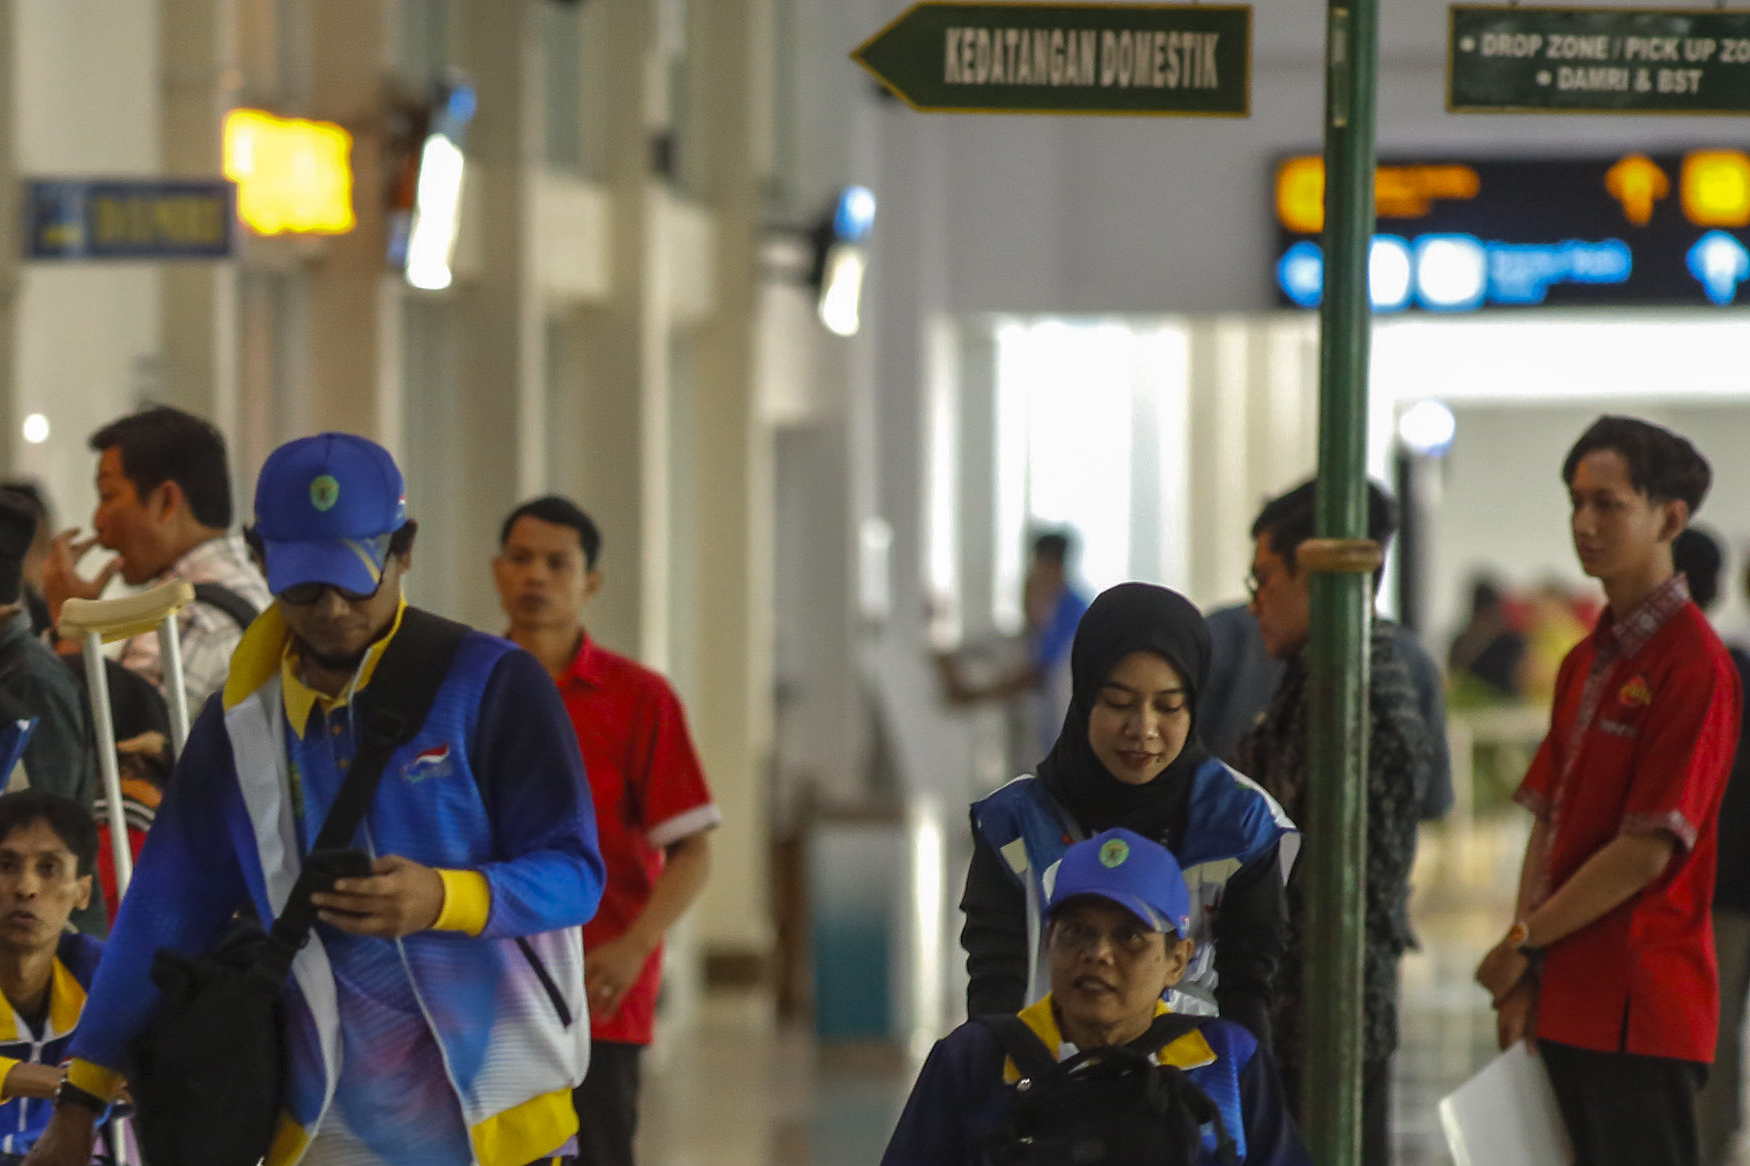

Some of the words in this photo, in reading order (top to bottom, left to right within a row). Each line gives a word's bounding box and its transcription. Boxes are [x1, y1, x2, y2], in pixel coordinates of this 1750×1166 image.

[945, 28, 1097, 87] KEDATANGAN
[1101, 29, 1219, 89] DOMESTIK
[1480, 32, 1543, 57] DROP
[1546, 34, 1609, 60] ZONE
[1625, 36, 1680, 62] PICK
[1684, 37, 1716, 62] UP
[1558, 66, 1629, 92] DAMRI
[1635, 67, 1651, 93] &
[1657, 68, 1703, 94] BST
